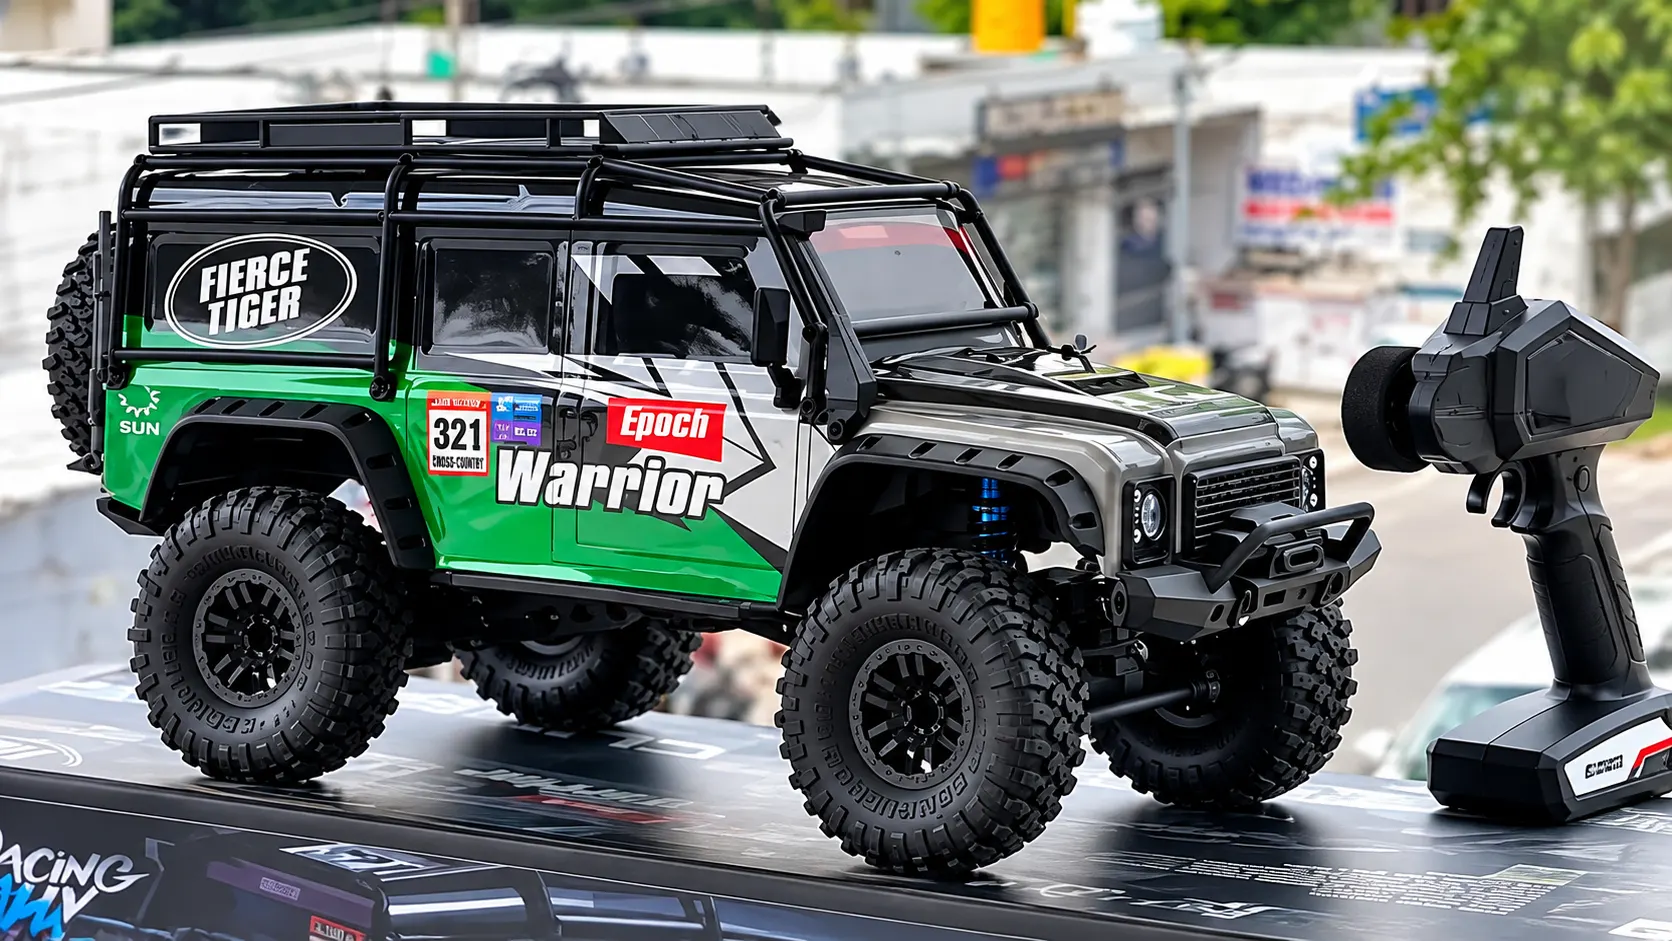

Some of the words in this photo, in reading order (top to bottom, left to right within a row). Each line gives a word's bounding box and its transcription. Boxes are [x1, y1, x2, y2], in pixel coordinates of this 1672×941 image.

[200, 248, 310, 303] FIERCE
[208, 285, 301, 335] TIGER
[120, 421, 160, 435] SUN
[434, 418, 480, 450] 321
[620, 406, 708, 441] Epoch
[496, 448, 725, 518] Warrior
